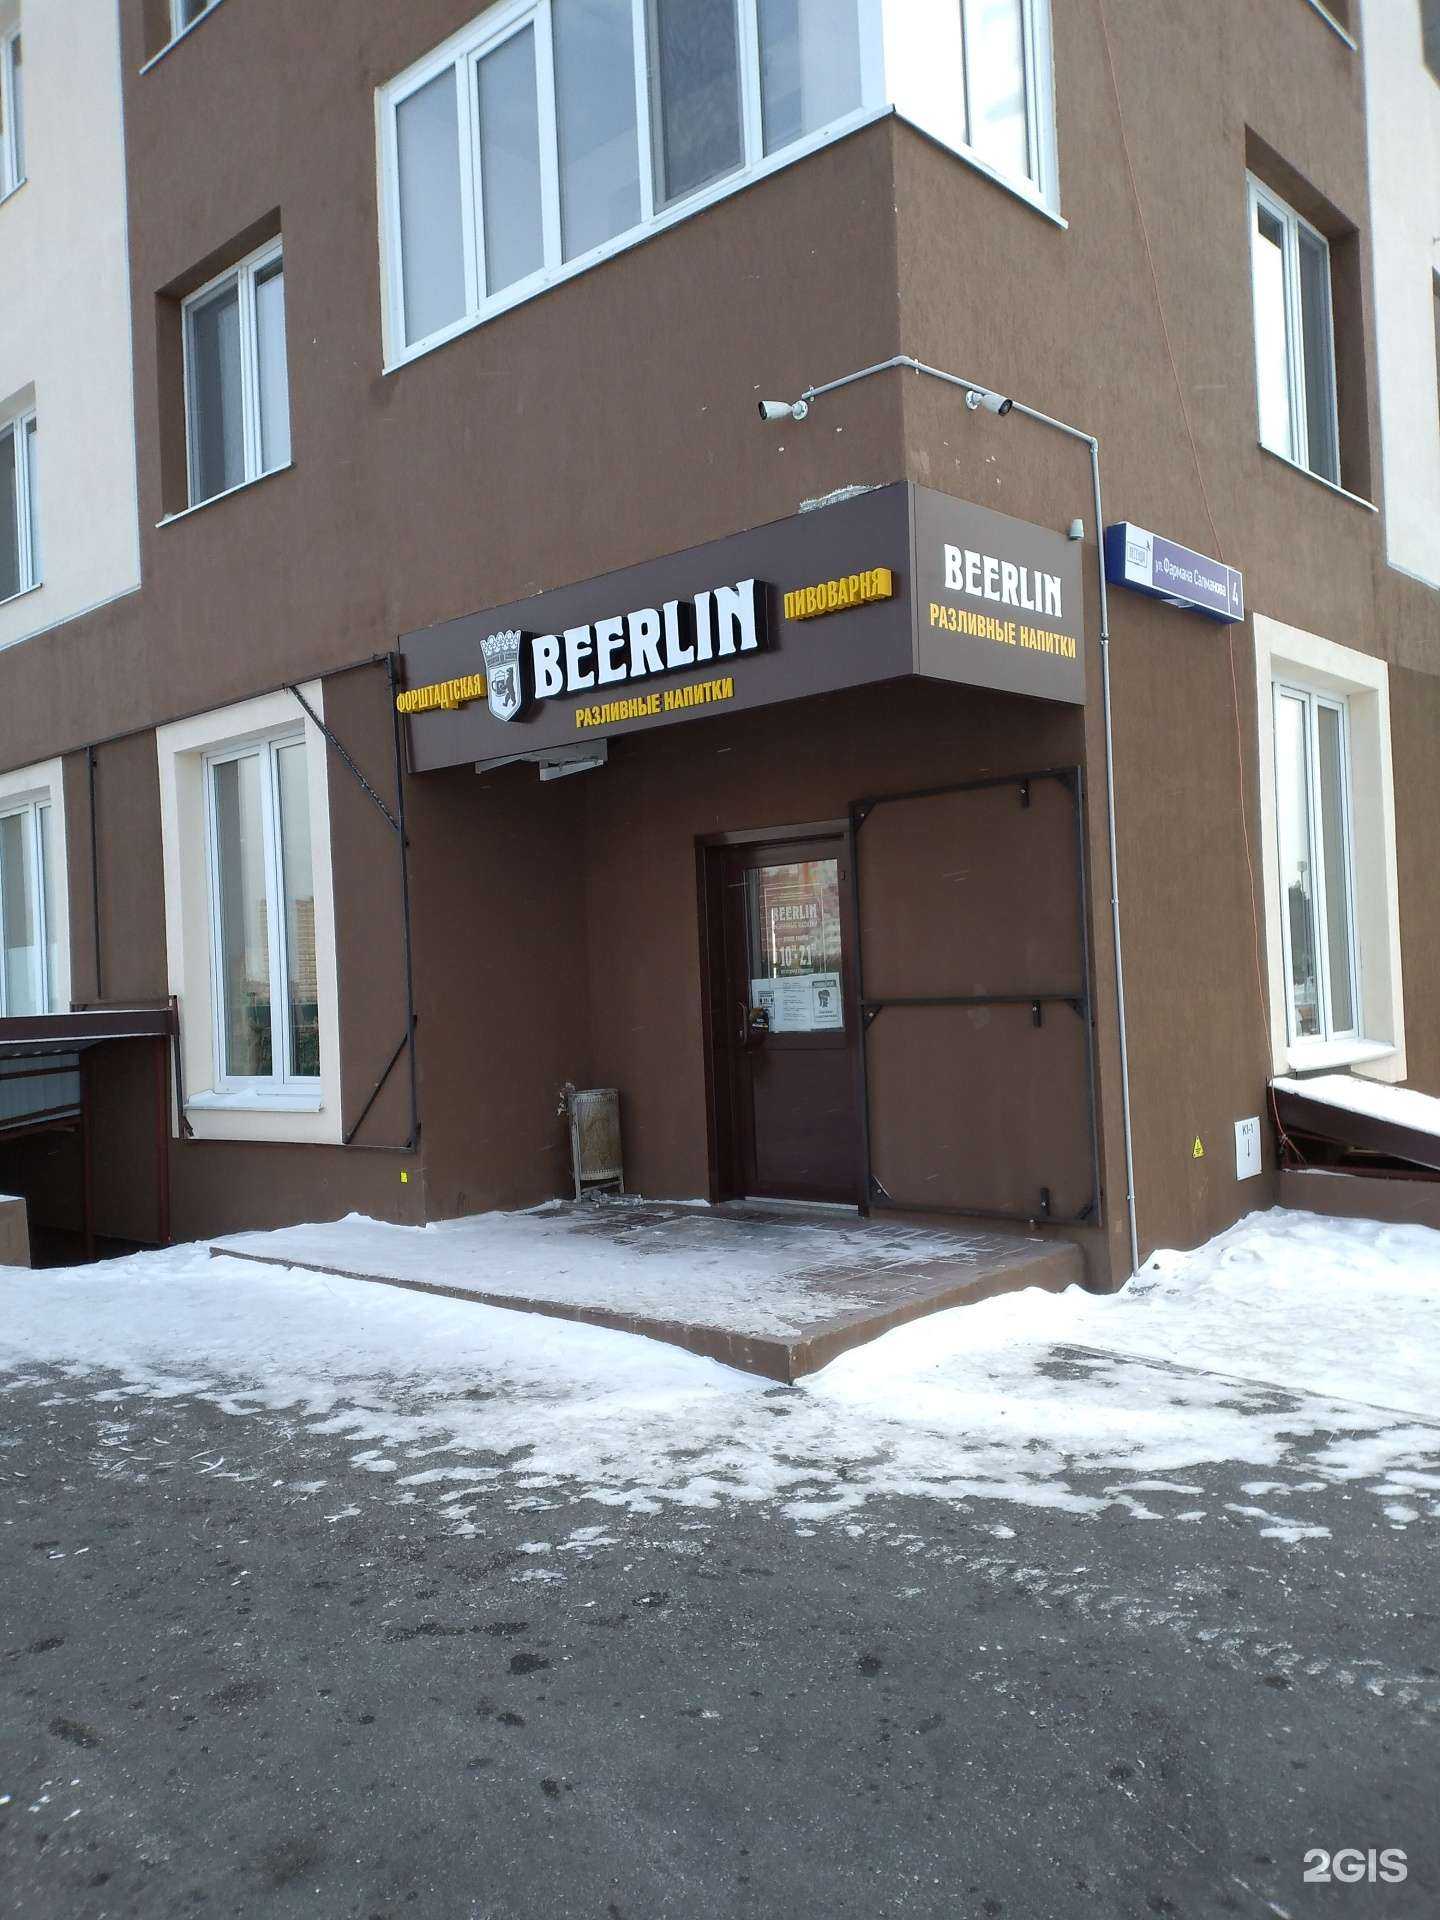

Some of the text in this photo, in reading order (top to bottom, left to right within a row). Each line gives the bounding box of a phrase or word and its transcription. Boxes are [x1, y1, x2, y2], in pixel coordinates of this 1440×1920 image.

[784, 568, 886, 619] ПИВОВАРНЯ
[944, 543, 1063, 618] BEERLIN
[1164, 558, 1193, 583] Фармана
[1194, 569, 1227, 597] Салманова
[1232, 582, 1239, 606] 4
[531, 578, 758, 699] BEERLIN
[929, 602, 1077, 659] РАЗЛИВНЫЕ НАПИТКИ
[396, 673, 483, 713] ФОРШТАДТСКАЯ
[576, 677, 734, 728] РАЗЛИВНЫЕ НАПИТКИ
[771, 904, 817, 921] BEERLIN
